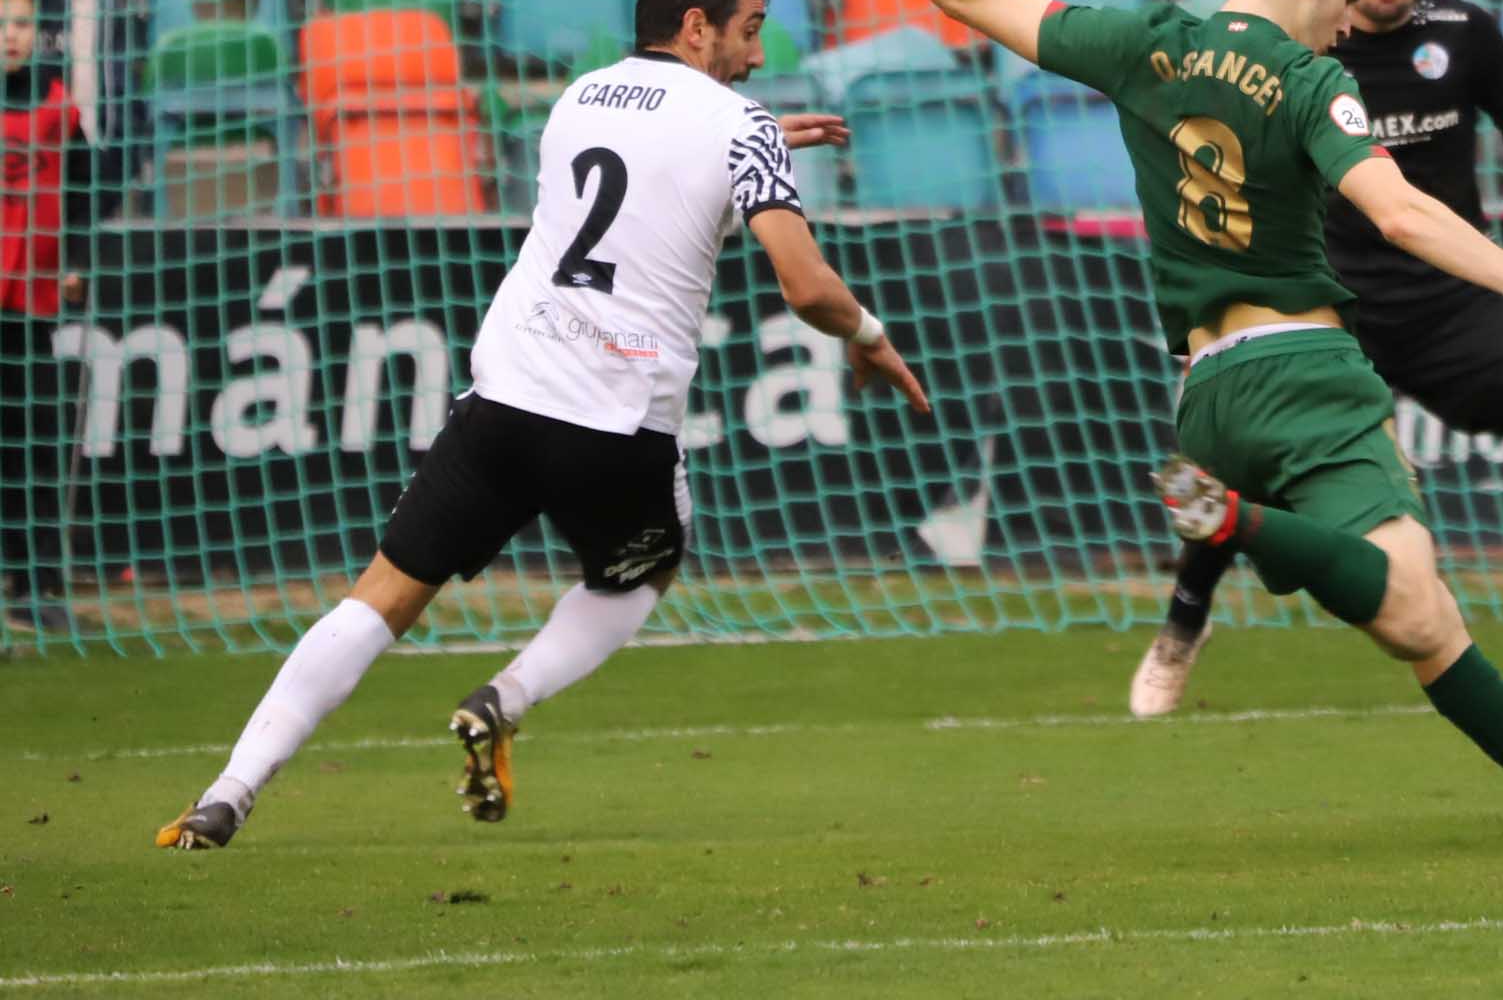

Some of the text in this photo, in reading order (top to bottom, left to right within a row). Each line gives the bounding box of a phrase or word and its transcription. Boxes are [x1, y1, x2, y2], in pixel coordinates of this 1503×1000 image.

[577, 83, 666, 111] CARPIO
[551, 146, 628, 295] 2
[1168, 116, 1255, 252] 8
